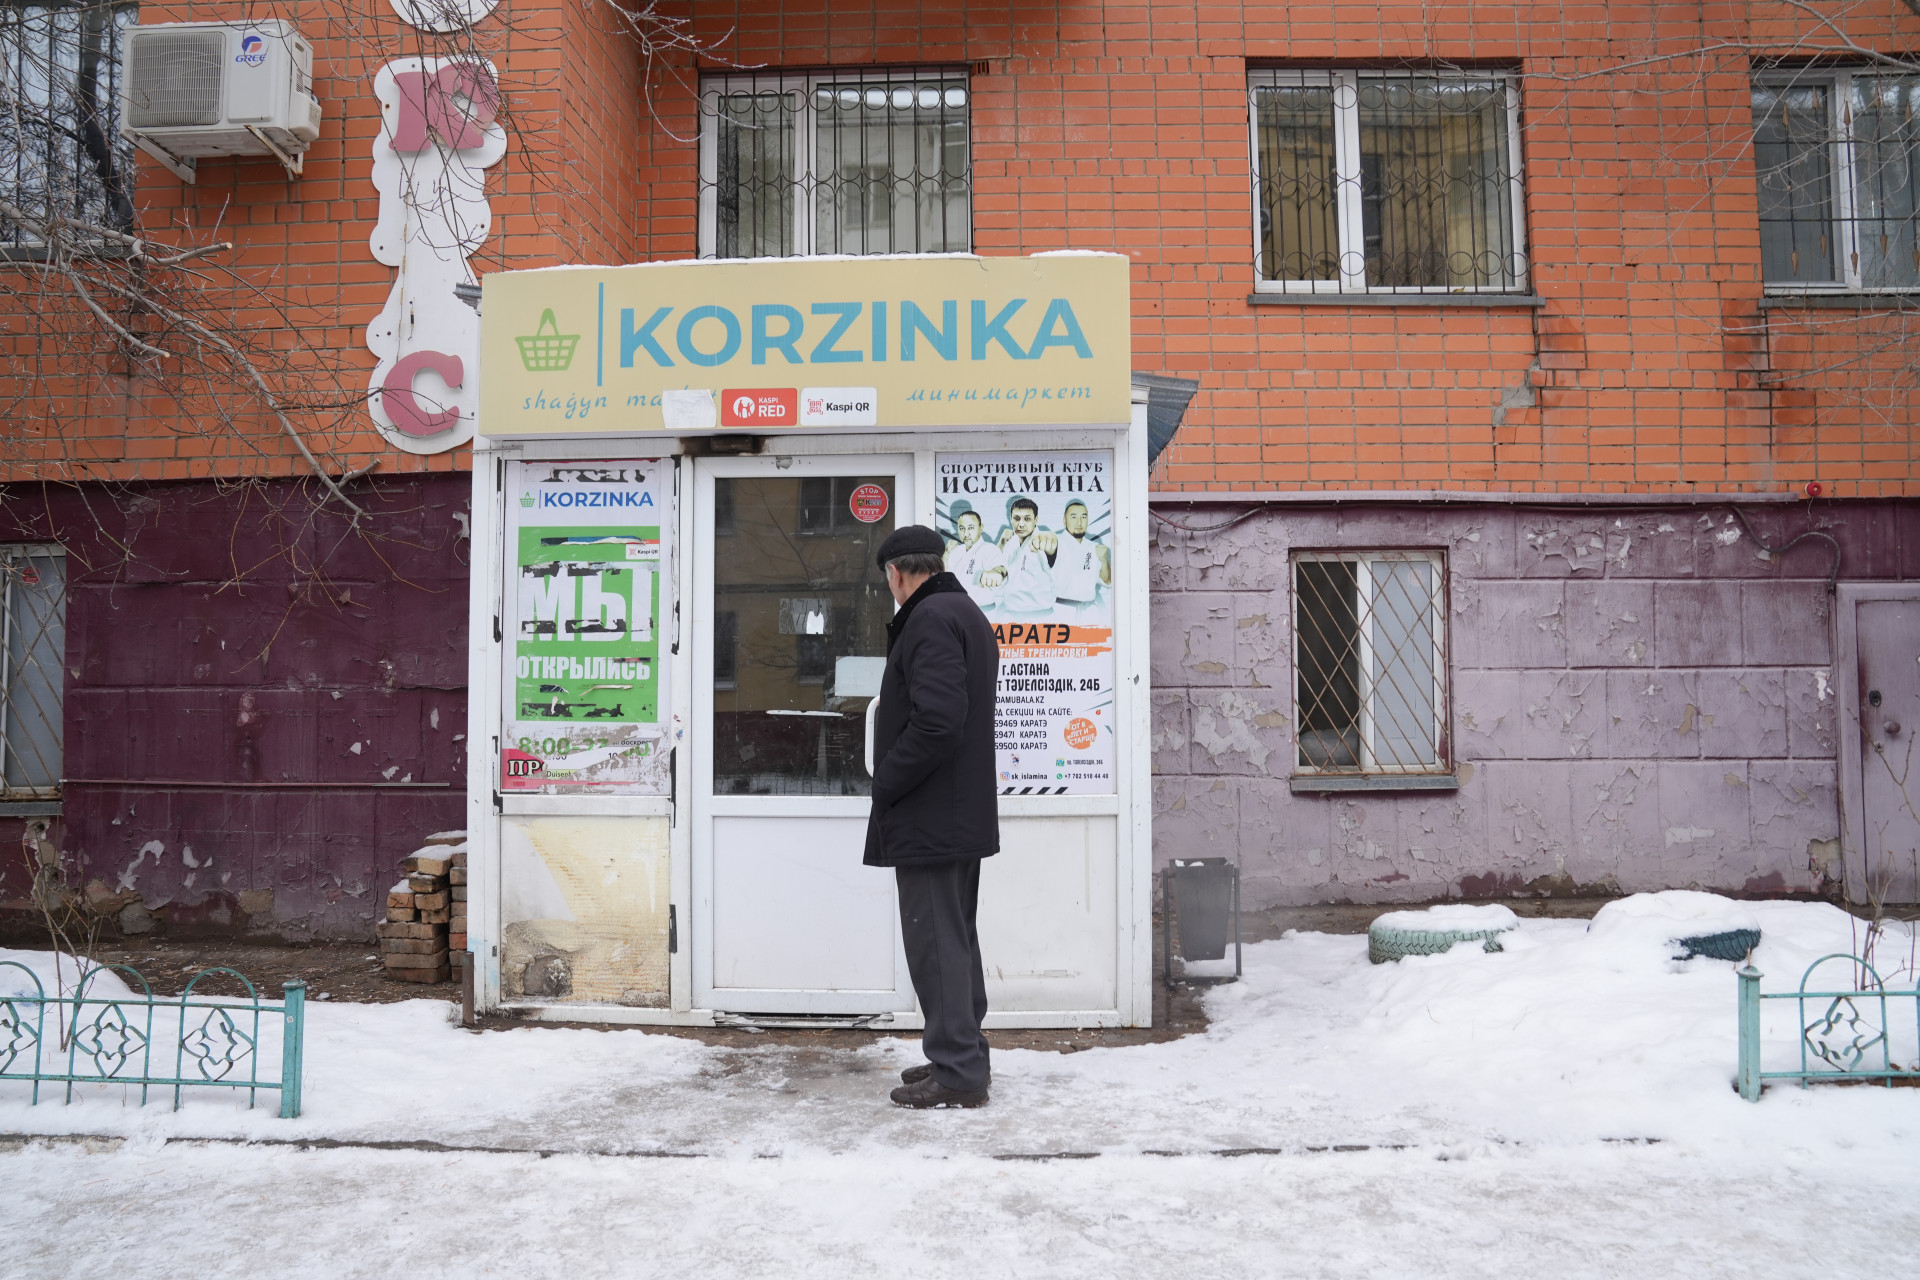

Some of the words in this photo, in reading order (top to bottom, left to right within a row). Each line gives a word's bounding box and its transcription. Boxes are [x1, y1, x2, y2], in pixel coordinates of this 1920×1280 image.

[235, 54, 266, 62] GREE
[619, 297, 1094, 369] KORZINKA
[906, 387, 1092, 409] минимаркет
[758, 405, 786, 418] RED
[826, 402, 853, 413] Kaspi
[855, 402, 870, 412] QR
[940, 461, 1055, 474] СПОРТИВНЫЙ
[1062, 462, 1103, 473] КЛУБ
[940, 475, 1105, 493] ИСЛАМИНА
[544, 491, 654, 507] KORZINKA
[516, 566, 653, 642] МЫ
[994, 624, 1071, 644] АРАТЭ
[999, 648, 1025, 658] ТНЫЕ
[1028, 647, 1088, 658] ТРЕНИРОВКИ
[516, 656, 650, 681] ОТКРЫЛИСЬ
[1080, 679, 1100, 691] 24Б
[1005, 708, 1034, 717] СЕКЦИИ
[1036, 708, 1046, 716] НА
[1020, 719, 1048, 728] КАРАТЭ
[1019, 730, 1047, 739] КАРАТЭ
[1020, 742, 1048, 750] КАРАТЭ
